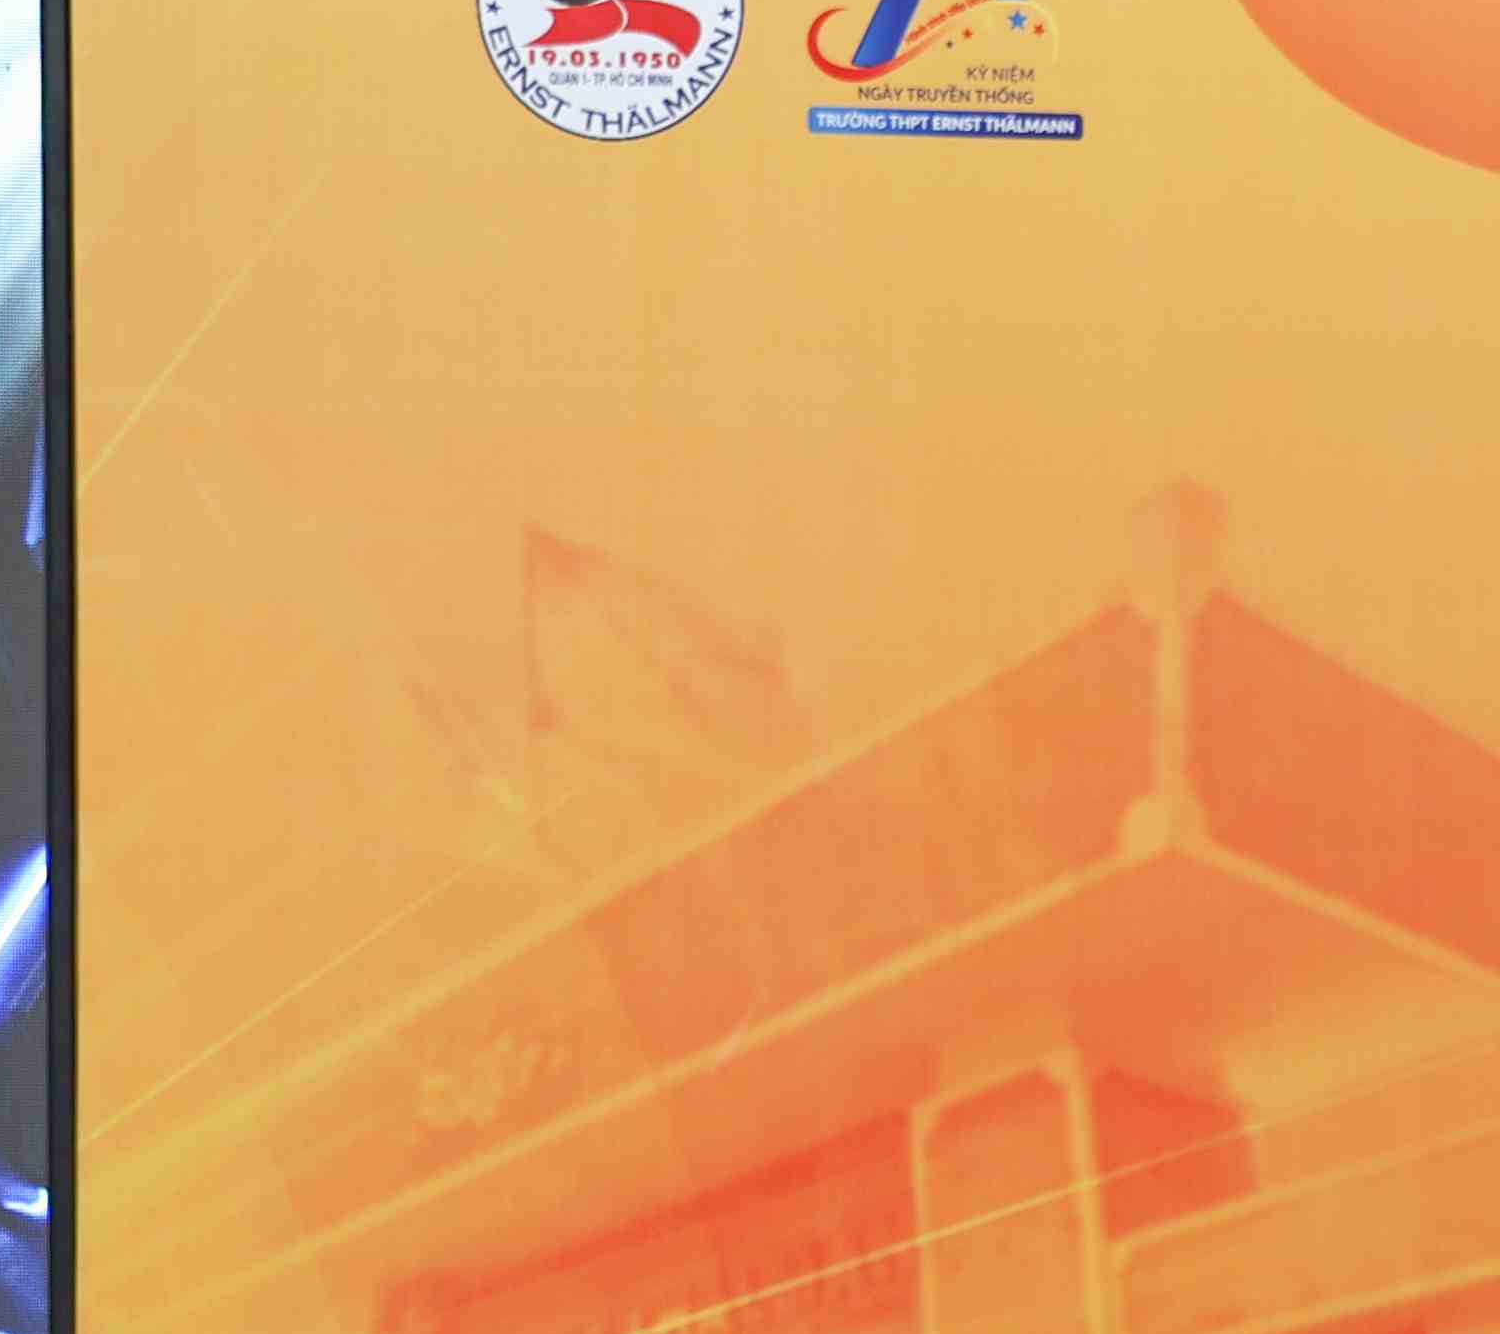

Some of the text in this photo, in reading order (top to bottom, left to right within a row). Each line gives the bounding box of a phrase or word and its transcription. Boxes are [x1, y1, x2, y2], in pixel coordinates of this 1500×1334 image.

[528, 50, 681, 70] 19.03.1950
[488, 25, 733, 134] ERNST THÄLMANN
[857, 85, 905, 101] NGÀY
[889, 115, 929, 131] THPT
[931, 116, 983, 132] ERNST
